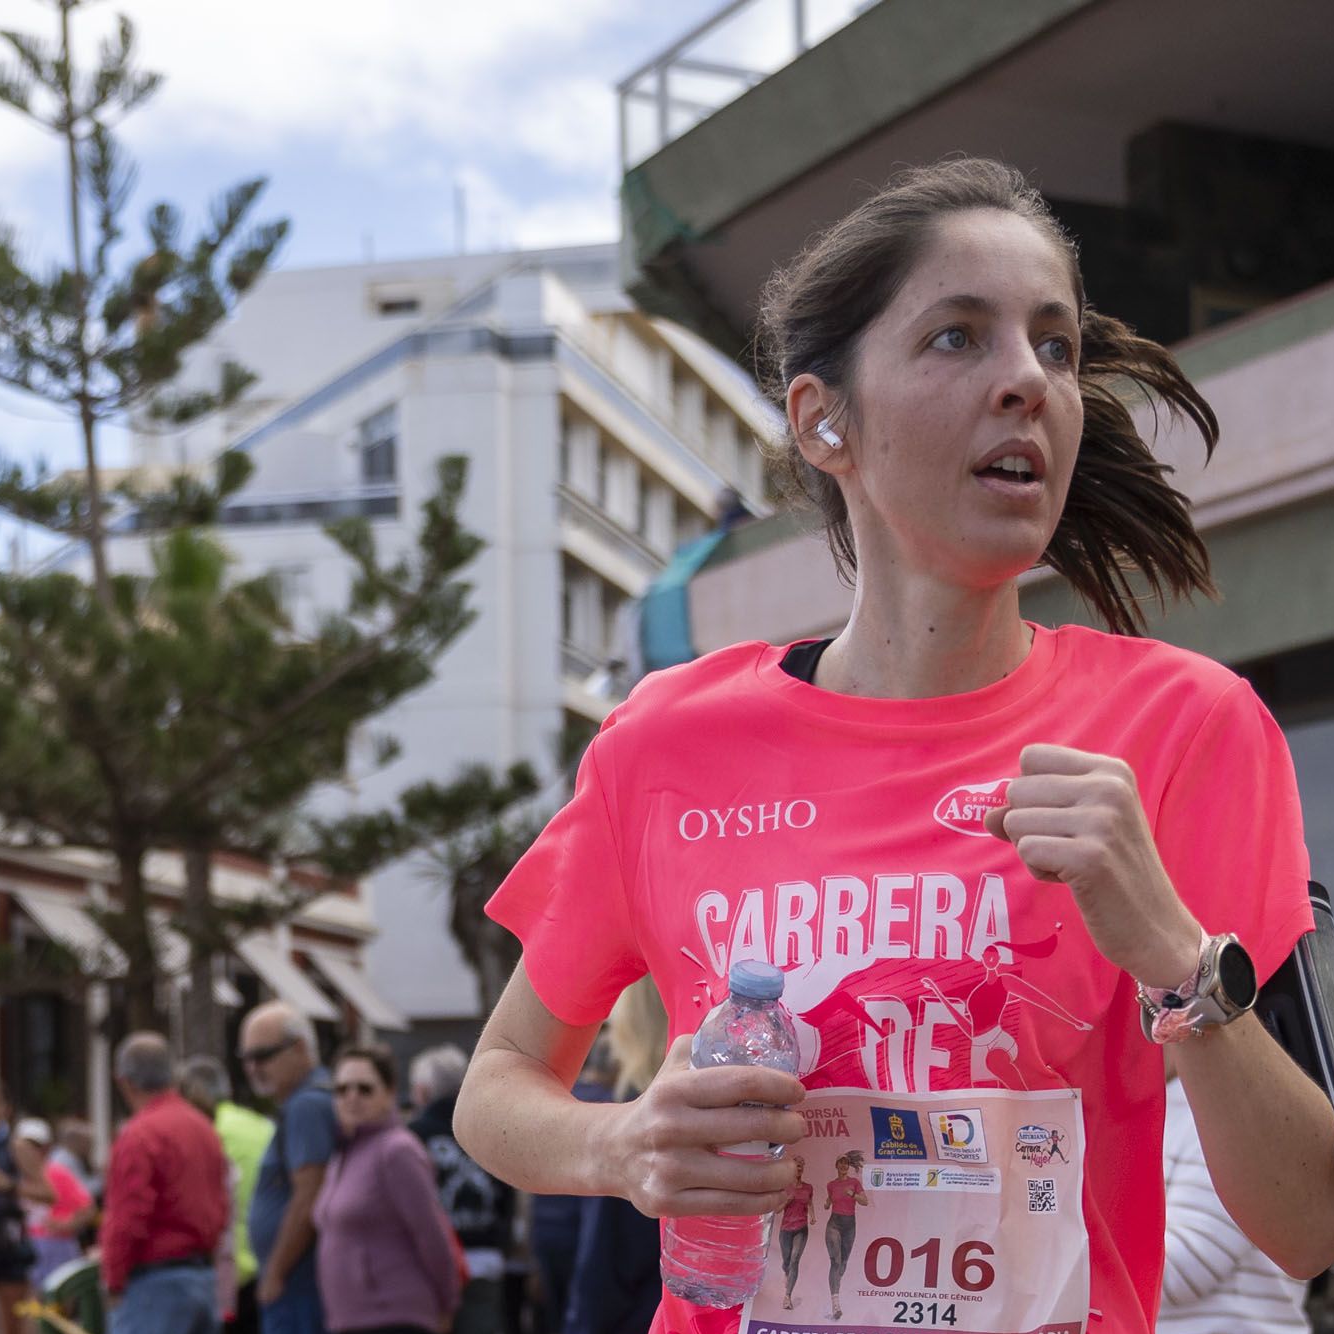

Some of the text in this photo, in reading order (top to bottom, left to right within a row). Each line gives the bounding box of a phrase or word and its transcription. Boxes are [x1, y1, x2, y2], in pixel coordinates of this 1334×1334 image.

[679, 799, 817, 841] OYSHO
[694, 872, 1013, 977] CARRERA
[897, 1148, 923, 1156] Canaria
[864, 1236, 995, 1292] 016
[858, 1289, 895, 1297] TELÉFONO
[896, 1291, 937, 1299] VIOLENCIA
[951, 1293, 983, 1302] GÉNERO
[893, 1300, 957, 1326] 2314
